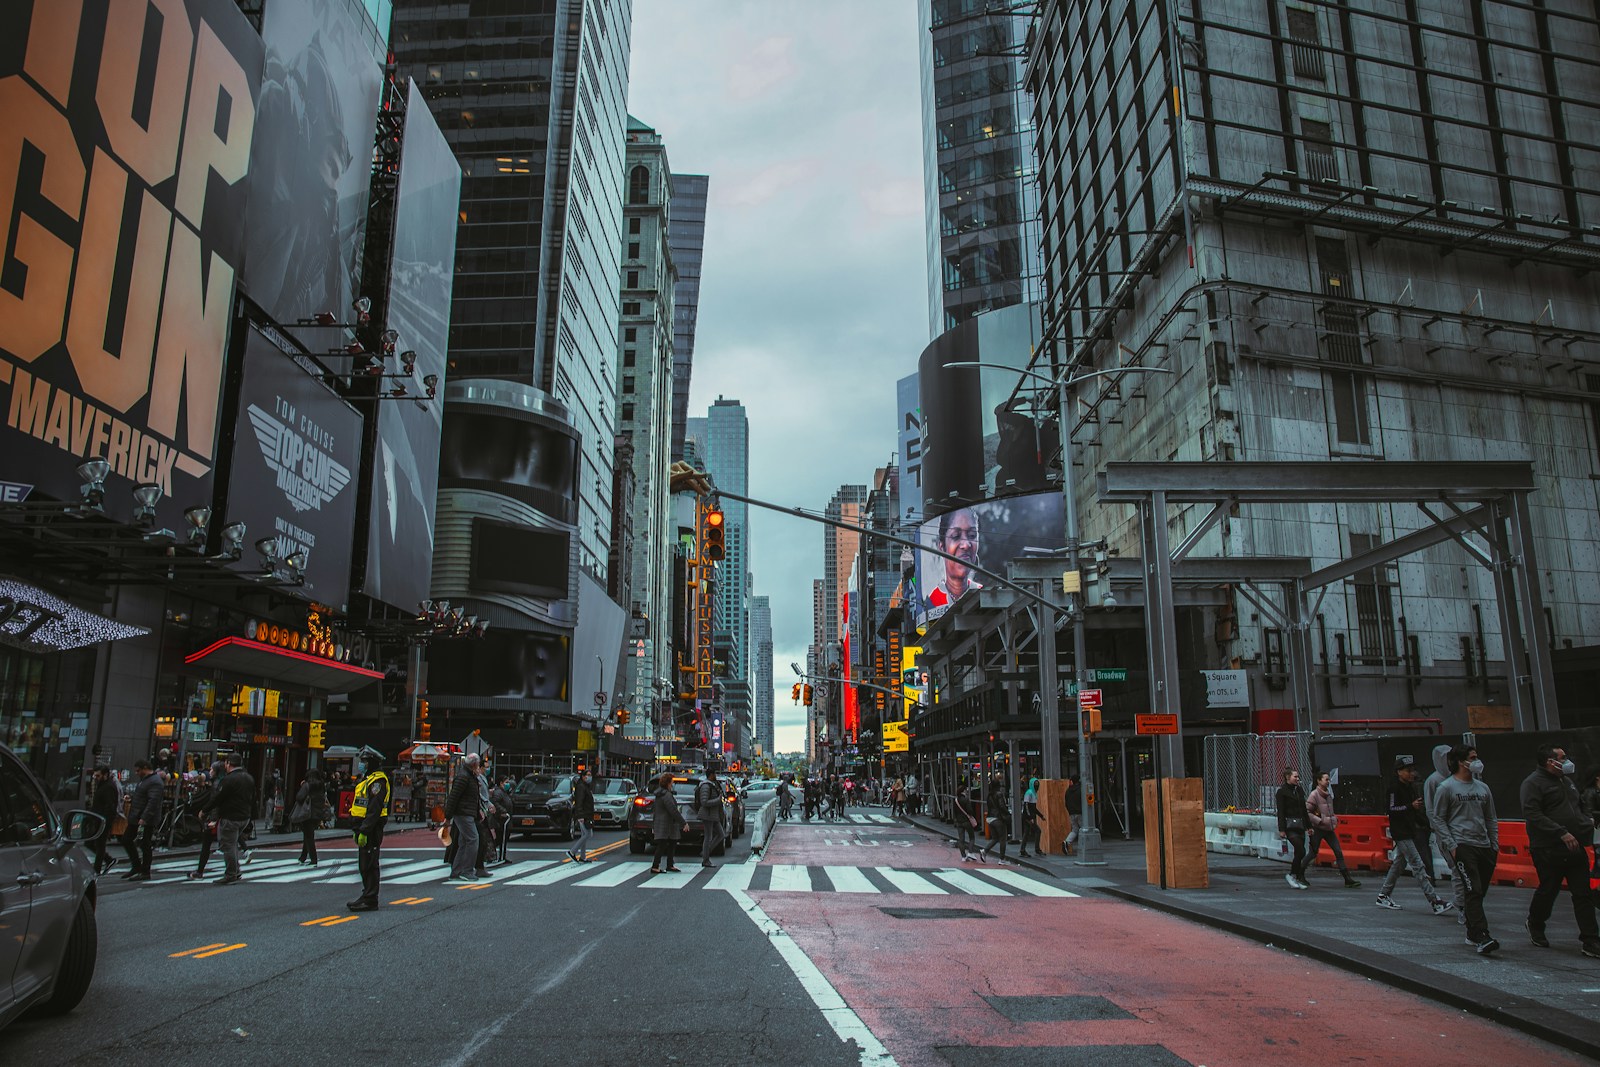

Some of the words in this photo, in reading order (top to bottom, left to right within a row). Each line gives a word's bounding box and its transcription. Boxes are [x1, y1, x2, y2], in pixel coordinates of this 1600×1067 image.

[0, 74, 236, 461] GUN
[7, 365, 182, 498] MAVERICK
[275, 395, 297, 425] TOM
[300, 414, 335, 453] CRUISE
[275, 424, 304, 473] TOP
[302, 442, 332, 494] GUN
[276, 464, 323, 512] MAVERICK
[275, 516, 288, 534] ONLY
[287, 522, 294, 537] IN
[277, 534, 297, 560] MAY
[889, 631, 899, 673] VICTORY
[636, 638, 646, 724] AMSTERDAM
[890, 676, 899, 699] NEW
[1097, 670, 1126, 681] Broadway
[1211, 673, 1237, 682] Square
[875, 692, 885, 710] NEW
